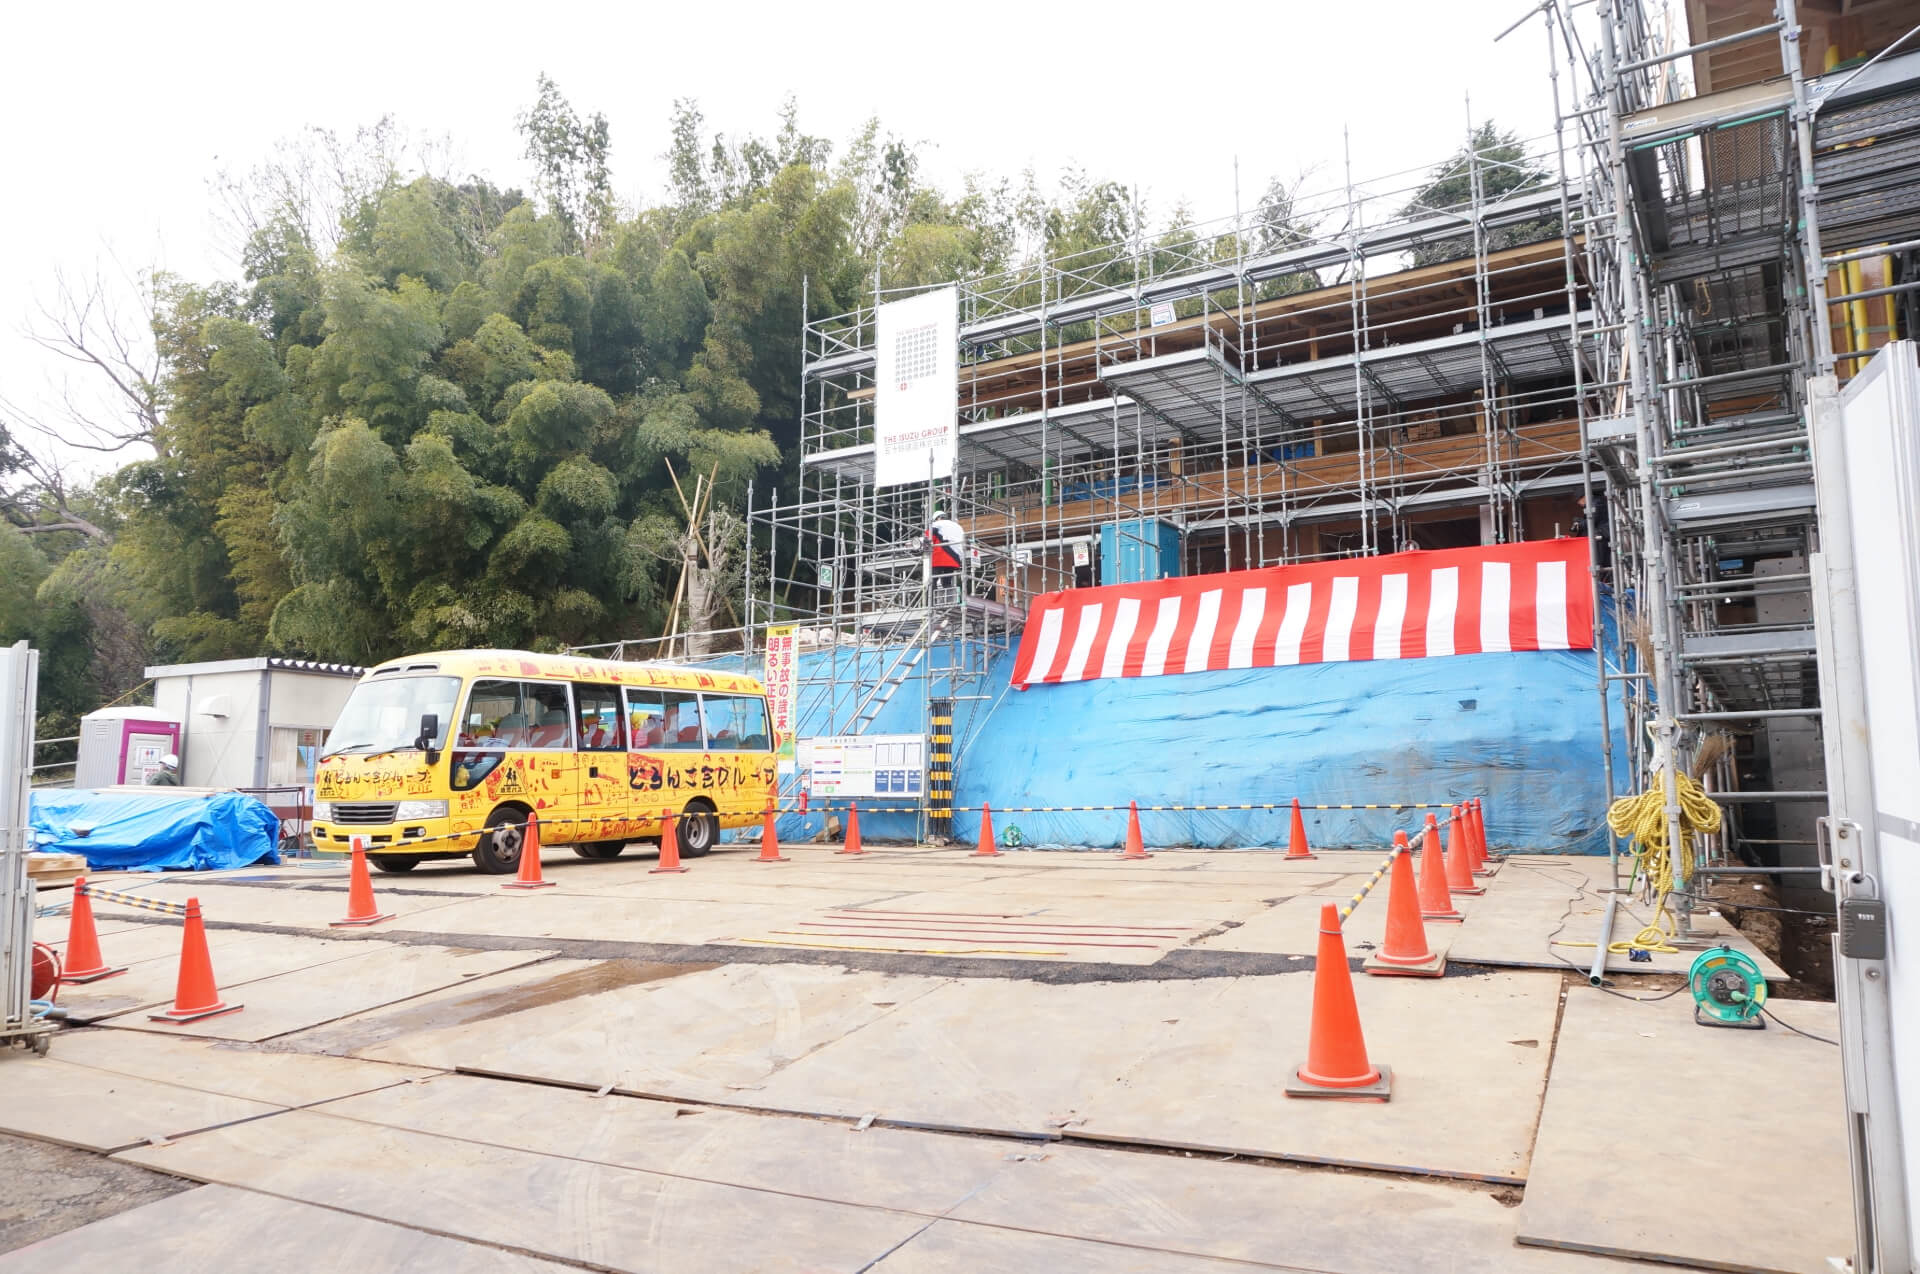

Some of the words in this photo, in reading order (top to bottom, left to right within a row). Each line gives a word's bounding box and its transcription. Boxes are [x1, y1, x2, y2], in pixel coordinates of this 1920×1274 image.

[884, 434, 897, 444] THE
[898, 430, 919, 442] ISUZU
[921, 426, 949, 438] GROUP
[777, 636, 793, 730] 無事故の歳末
